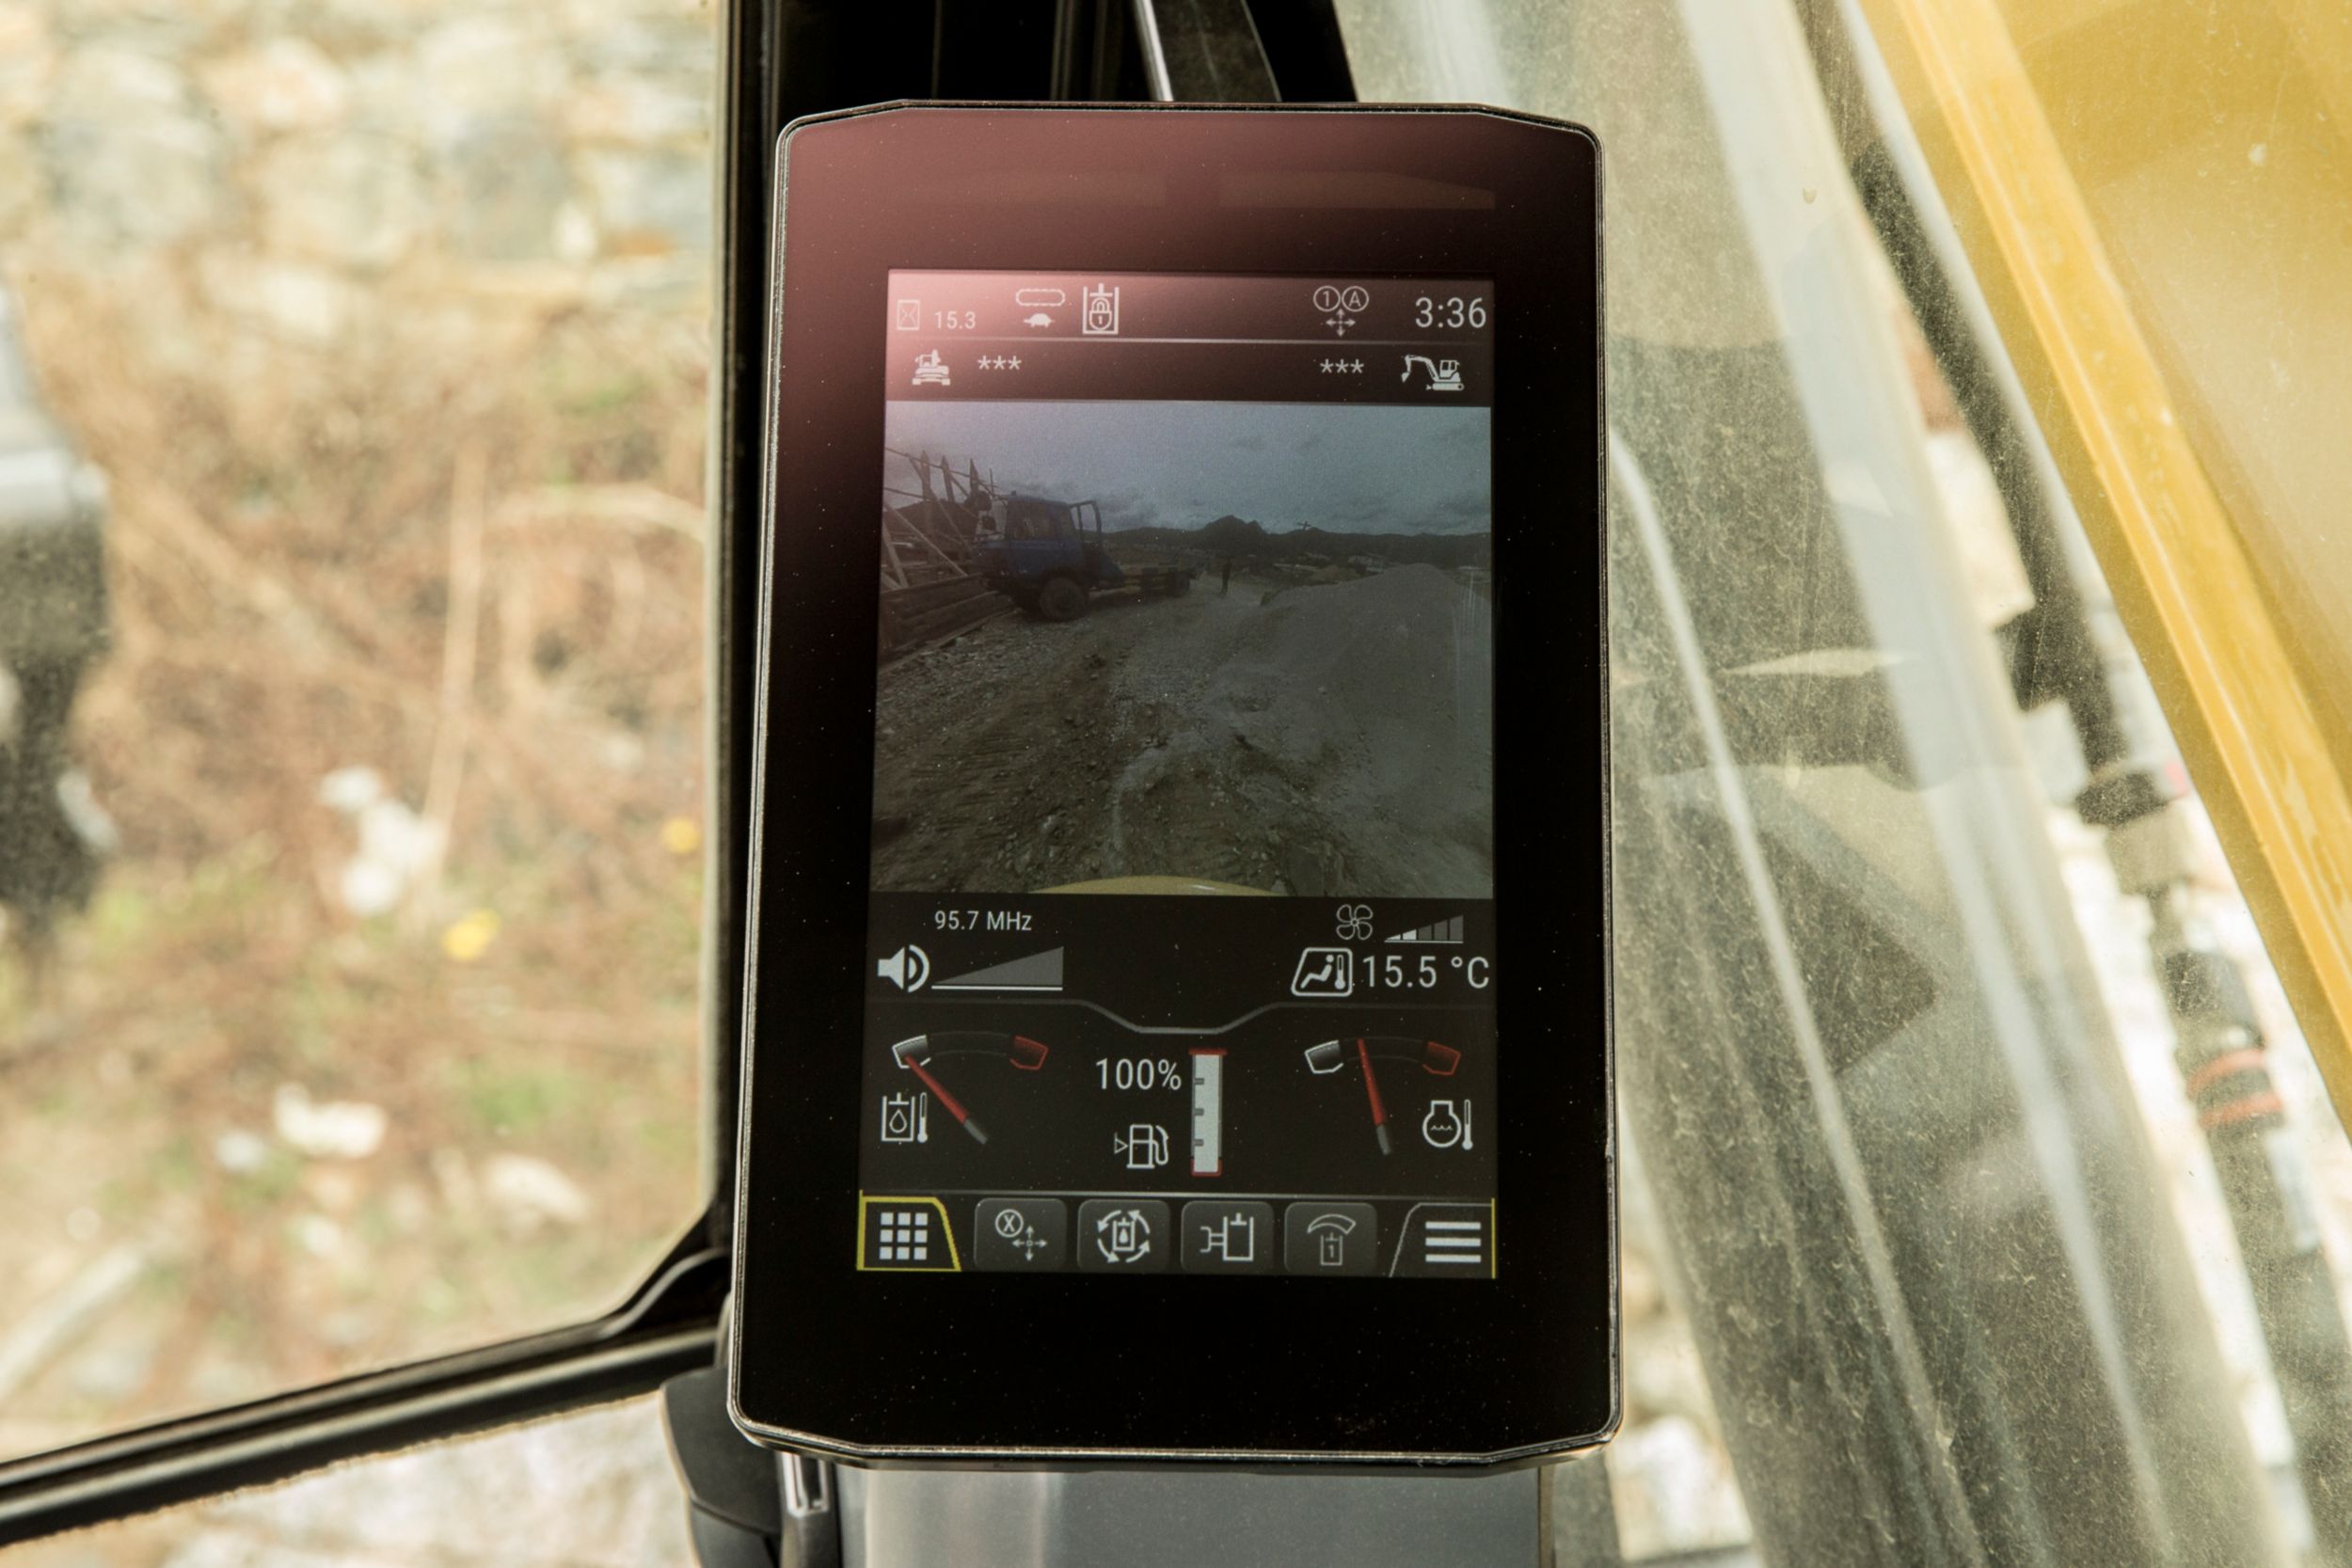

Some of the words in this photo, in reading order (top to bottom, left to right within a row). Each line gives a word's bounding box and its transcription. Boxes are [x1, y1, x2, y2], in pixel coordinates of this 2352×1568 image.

[934, 310, 976, 330] 15.3
[1415, 296, 1486, 329] 3:36
[934, 911, 978, 931] 95.7
[987, 911, 1032, 932] MHz
[1362, 956, 1438, 987] 15.5
[1451, 957, 1489, 988] °C
[1096, 1058, 1183, 1090] 100%
